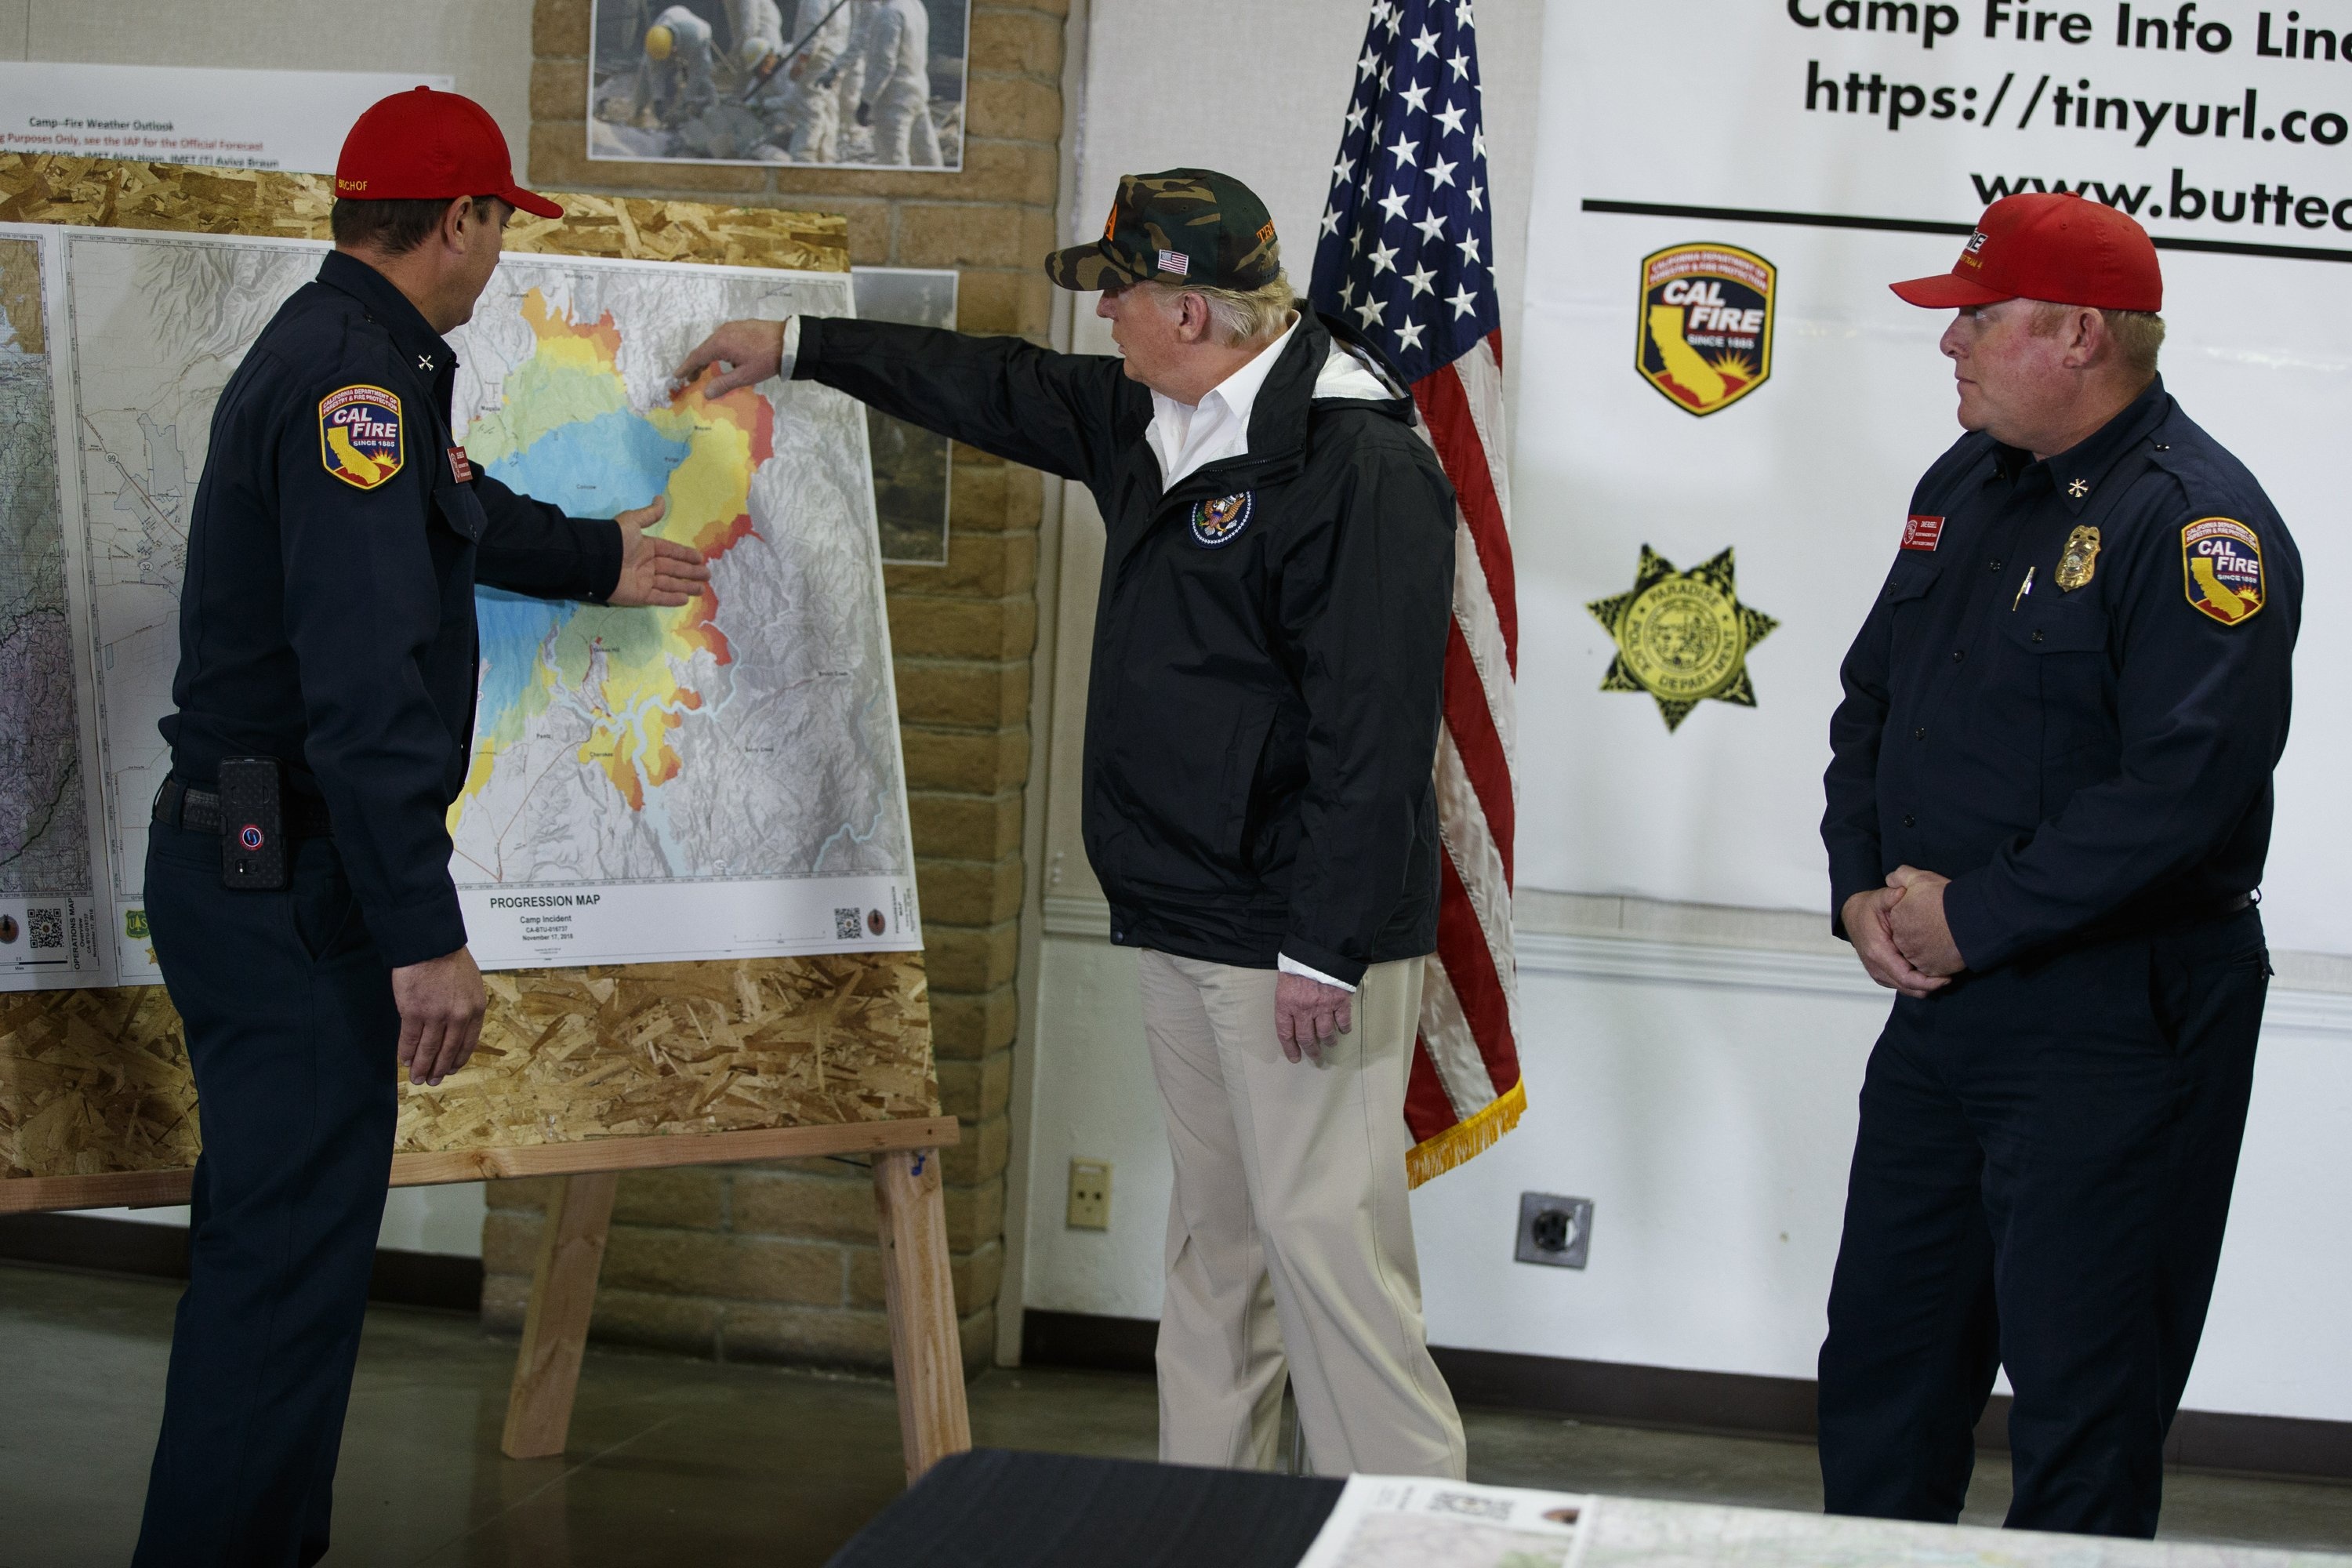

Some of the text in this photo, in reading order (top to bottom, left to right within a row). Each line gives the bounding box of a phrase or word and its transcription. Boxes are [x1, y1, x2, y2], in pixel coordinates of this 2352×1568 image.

[1787, 0, 1959, 49] Camp
[1984, 0, 2092, 45] Fire
[2116, 2, 2233, 54] Info
[1805, 60, 2349, 147] https://tinyurl.co
[86, 118, 129, 130] Weather
[133, 120, 173, 132] Outlook
[8, 132, 53, 144] Purposes
[103, 136, 120, 146] the
[161, 138, 176, 148] the
[1662, 278, 1726, 307] CAL
[1687, 306, 1765, 333] FIRE
[1686, 334, 1725, 347] SINCE
[323, 389, 354, 408] CALIFORNIA
[354, 388, 390, 401] DEPARTMENT
[366, 394, 397, 411] PROTECTION
[333, 407, 372, 423] CAL
[352, 423, 397, 437] FIRE
[2198, 540, 2236, 557] CAL
[2216, 557, 2259, 574] FIRE
[490, 894, 601, 908] PROGRESSION MAP
[520, 914, 572, 924] Camp Incident
[71, 917, 81, 970] OPERATIONS
